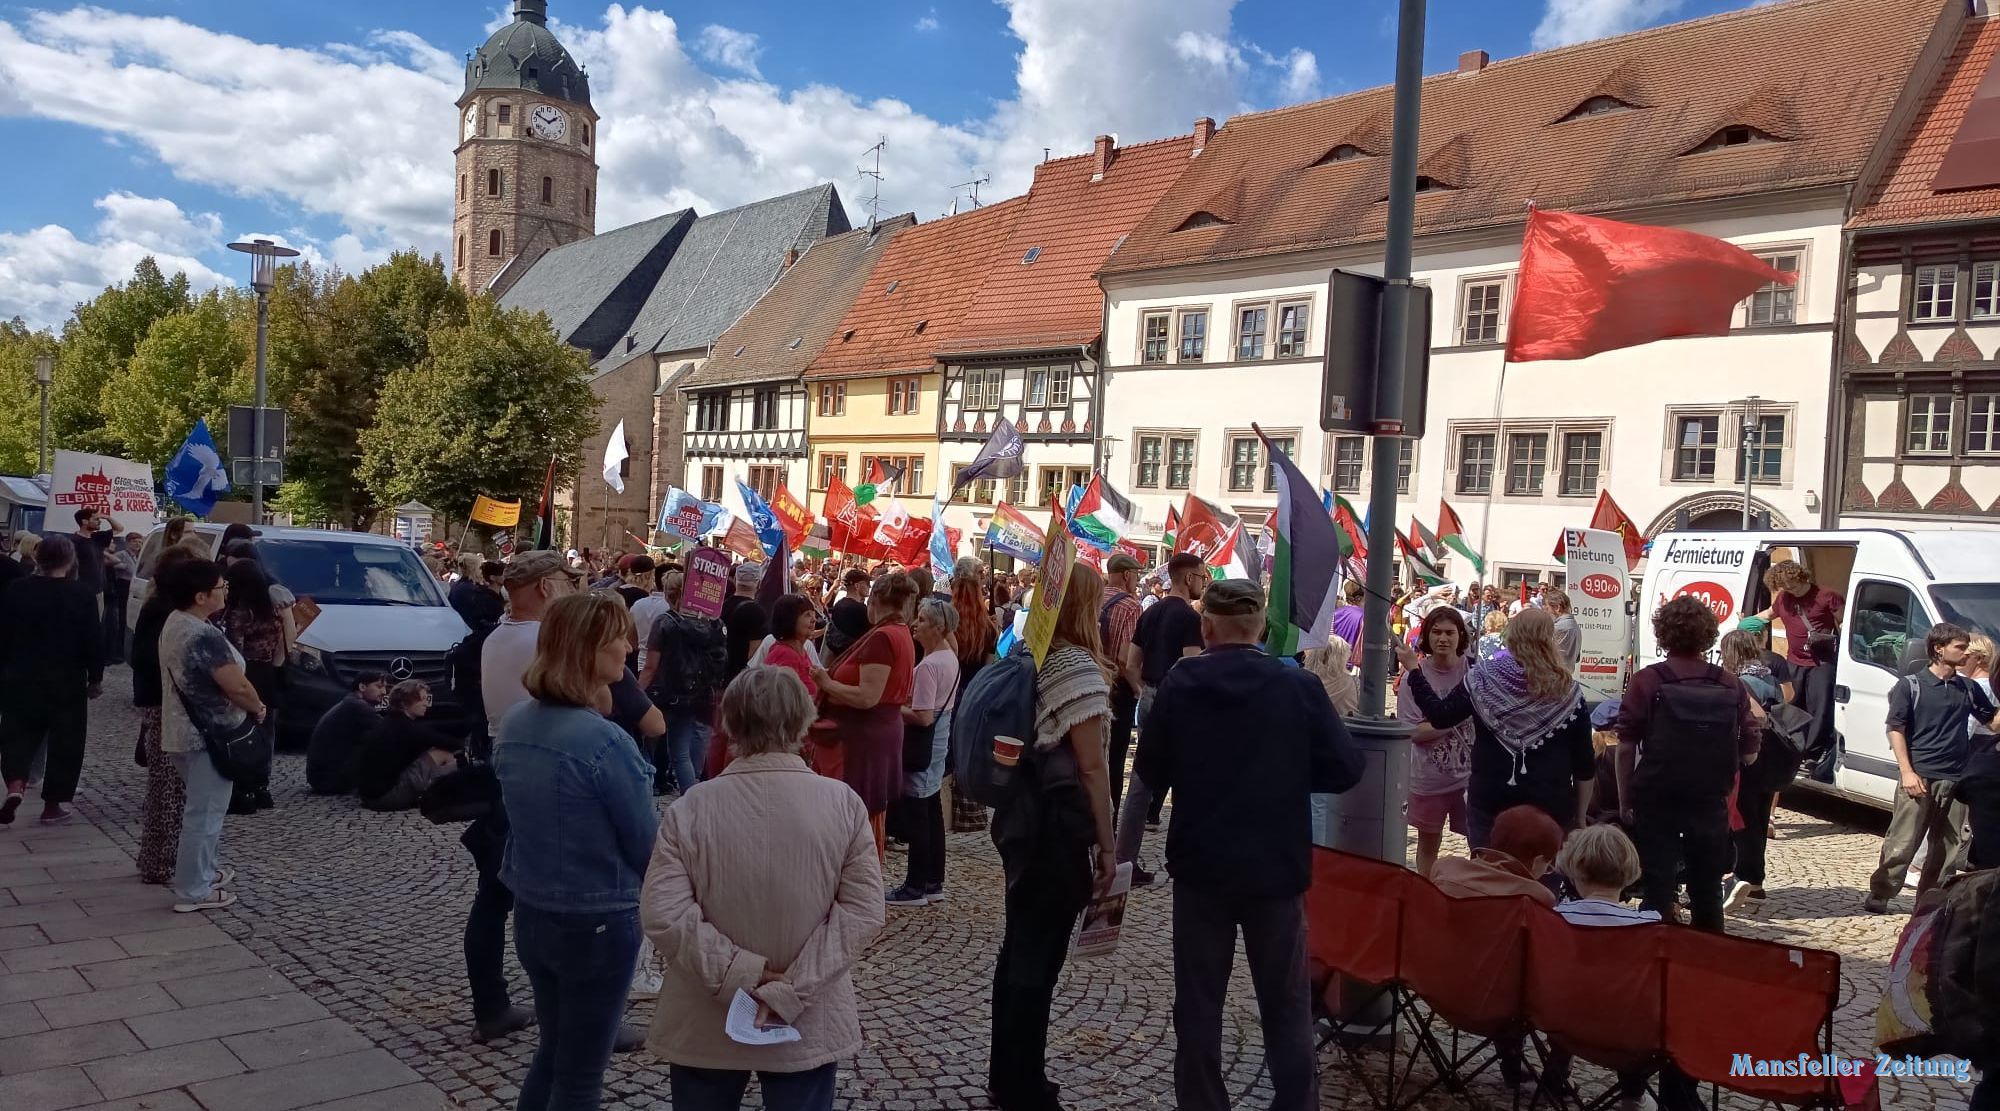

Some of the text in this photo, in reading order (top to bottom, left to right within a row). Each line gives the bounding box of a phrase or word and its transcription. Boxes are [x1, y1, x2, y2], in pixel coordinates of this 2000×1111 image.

[76, 481, 110, 493] KEEP
[56, 493, 97, 504] ELBIT
[113, 499, 153, 513] & KRIEG
[680, 510, 702, 522] KEEP
[680, 527, 697, 538] OUT
[1566, 530, 1587, 548] EX
[1567, 549, 1615, 565] mietung
[693, 556, 728, 579] STREIK!
[1568, 582, 1578, 591] ab
[1582, 607, 1599, 617] 406
[1601, 608, 1612, 619] 17
